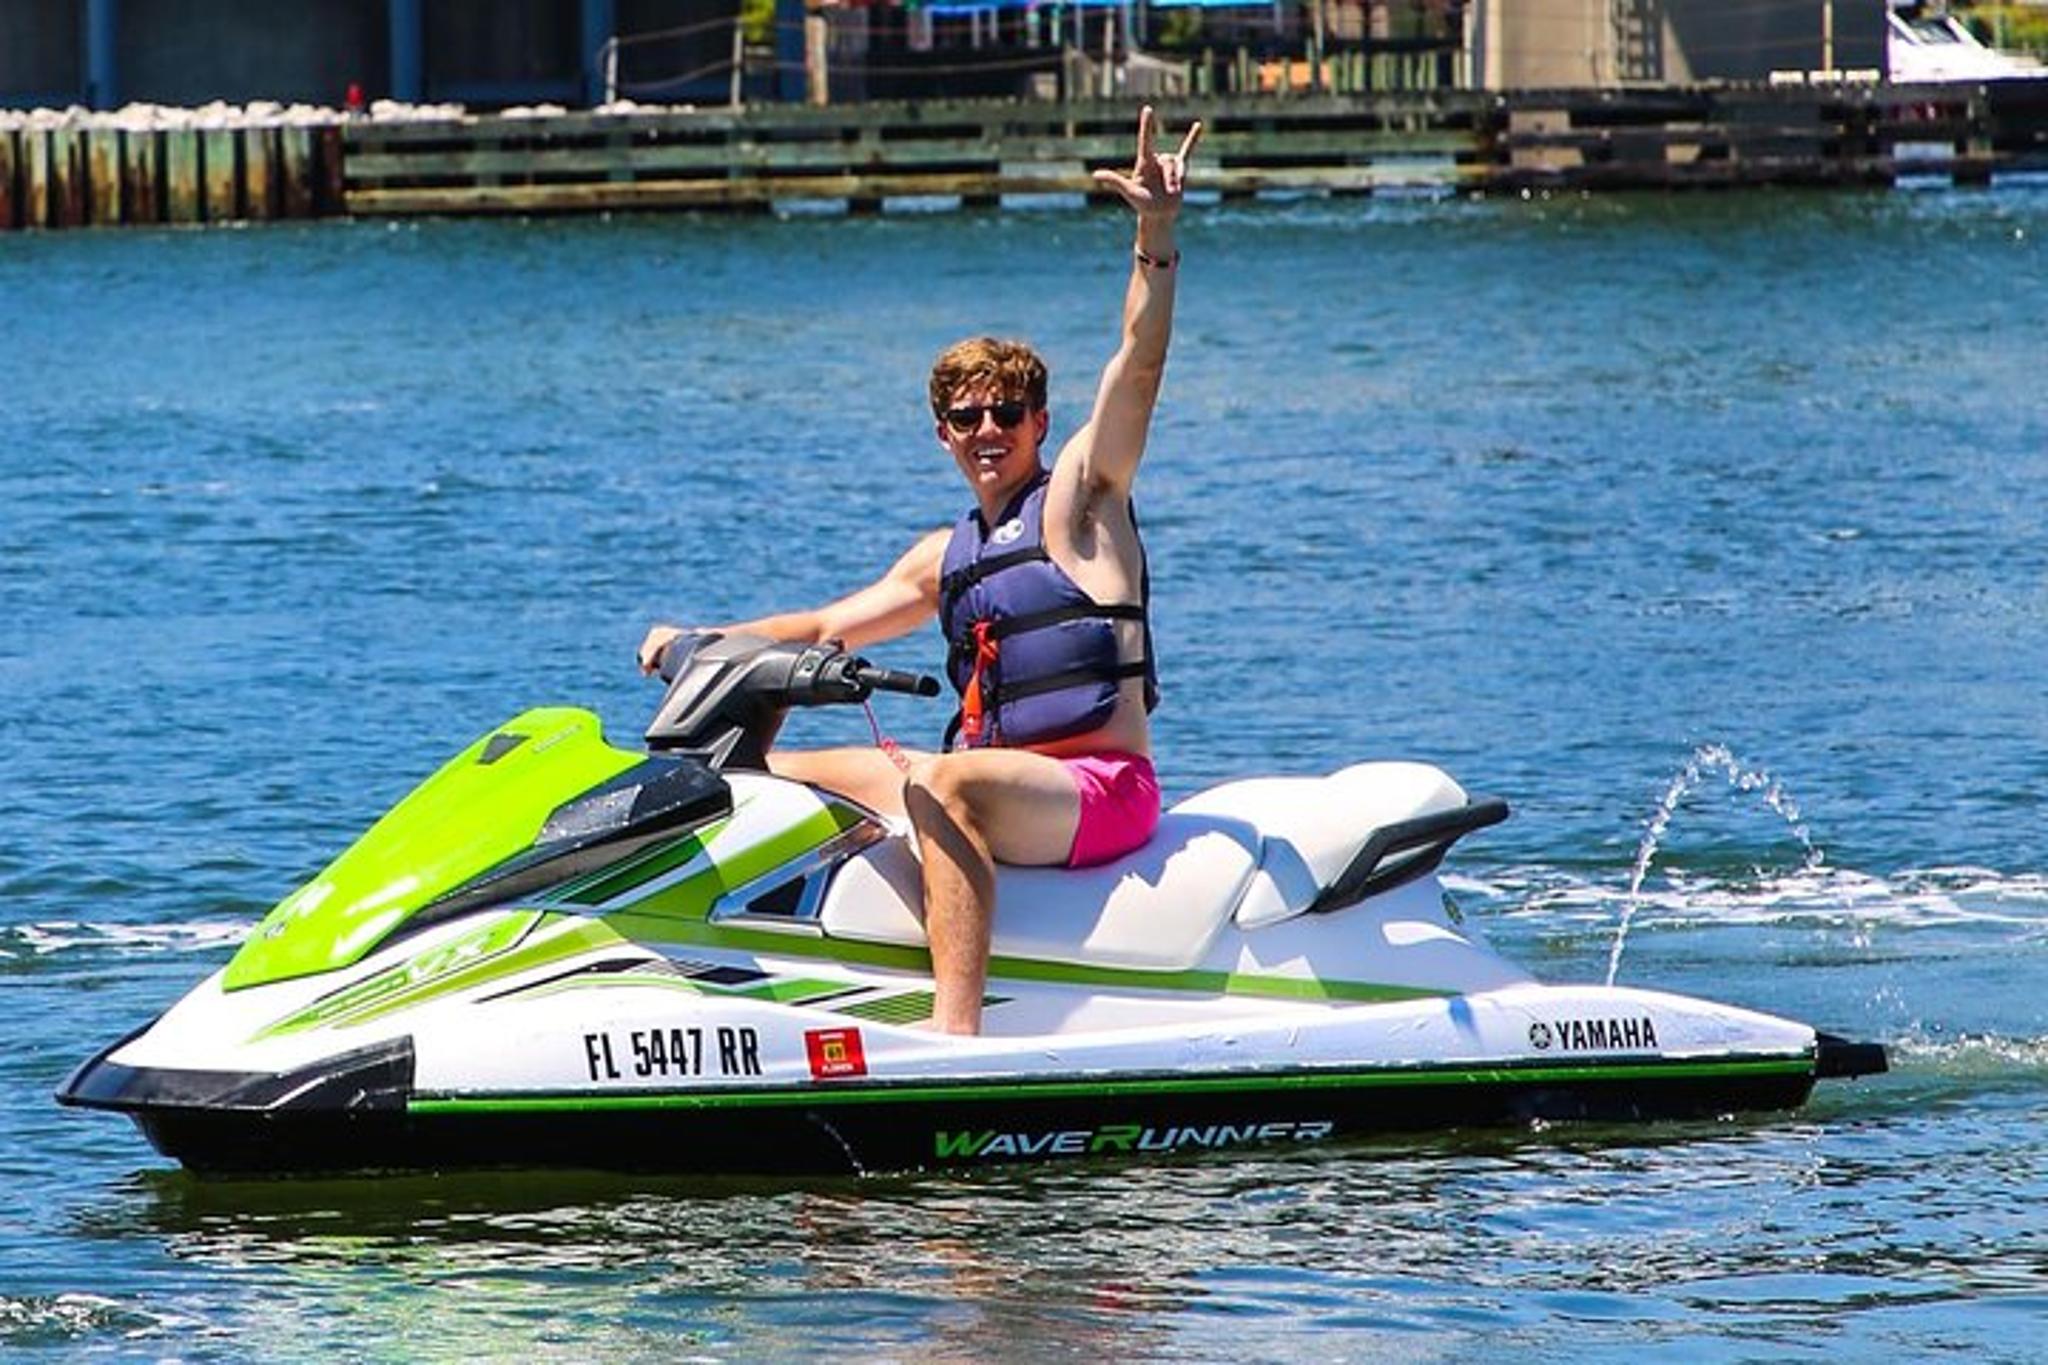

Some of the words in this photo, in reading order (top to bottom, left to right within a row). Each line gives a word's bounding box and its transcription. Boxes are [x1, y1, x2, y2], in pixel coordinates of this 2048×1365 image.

[583, 1032, 620, 1081] FL
[630, 1028, 702, 1076] 5447
[716, 1026, 762, 1075] RR
[1556, 1017, 1657, 1050] YAMAHA
